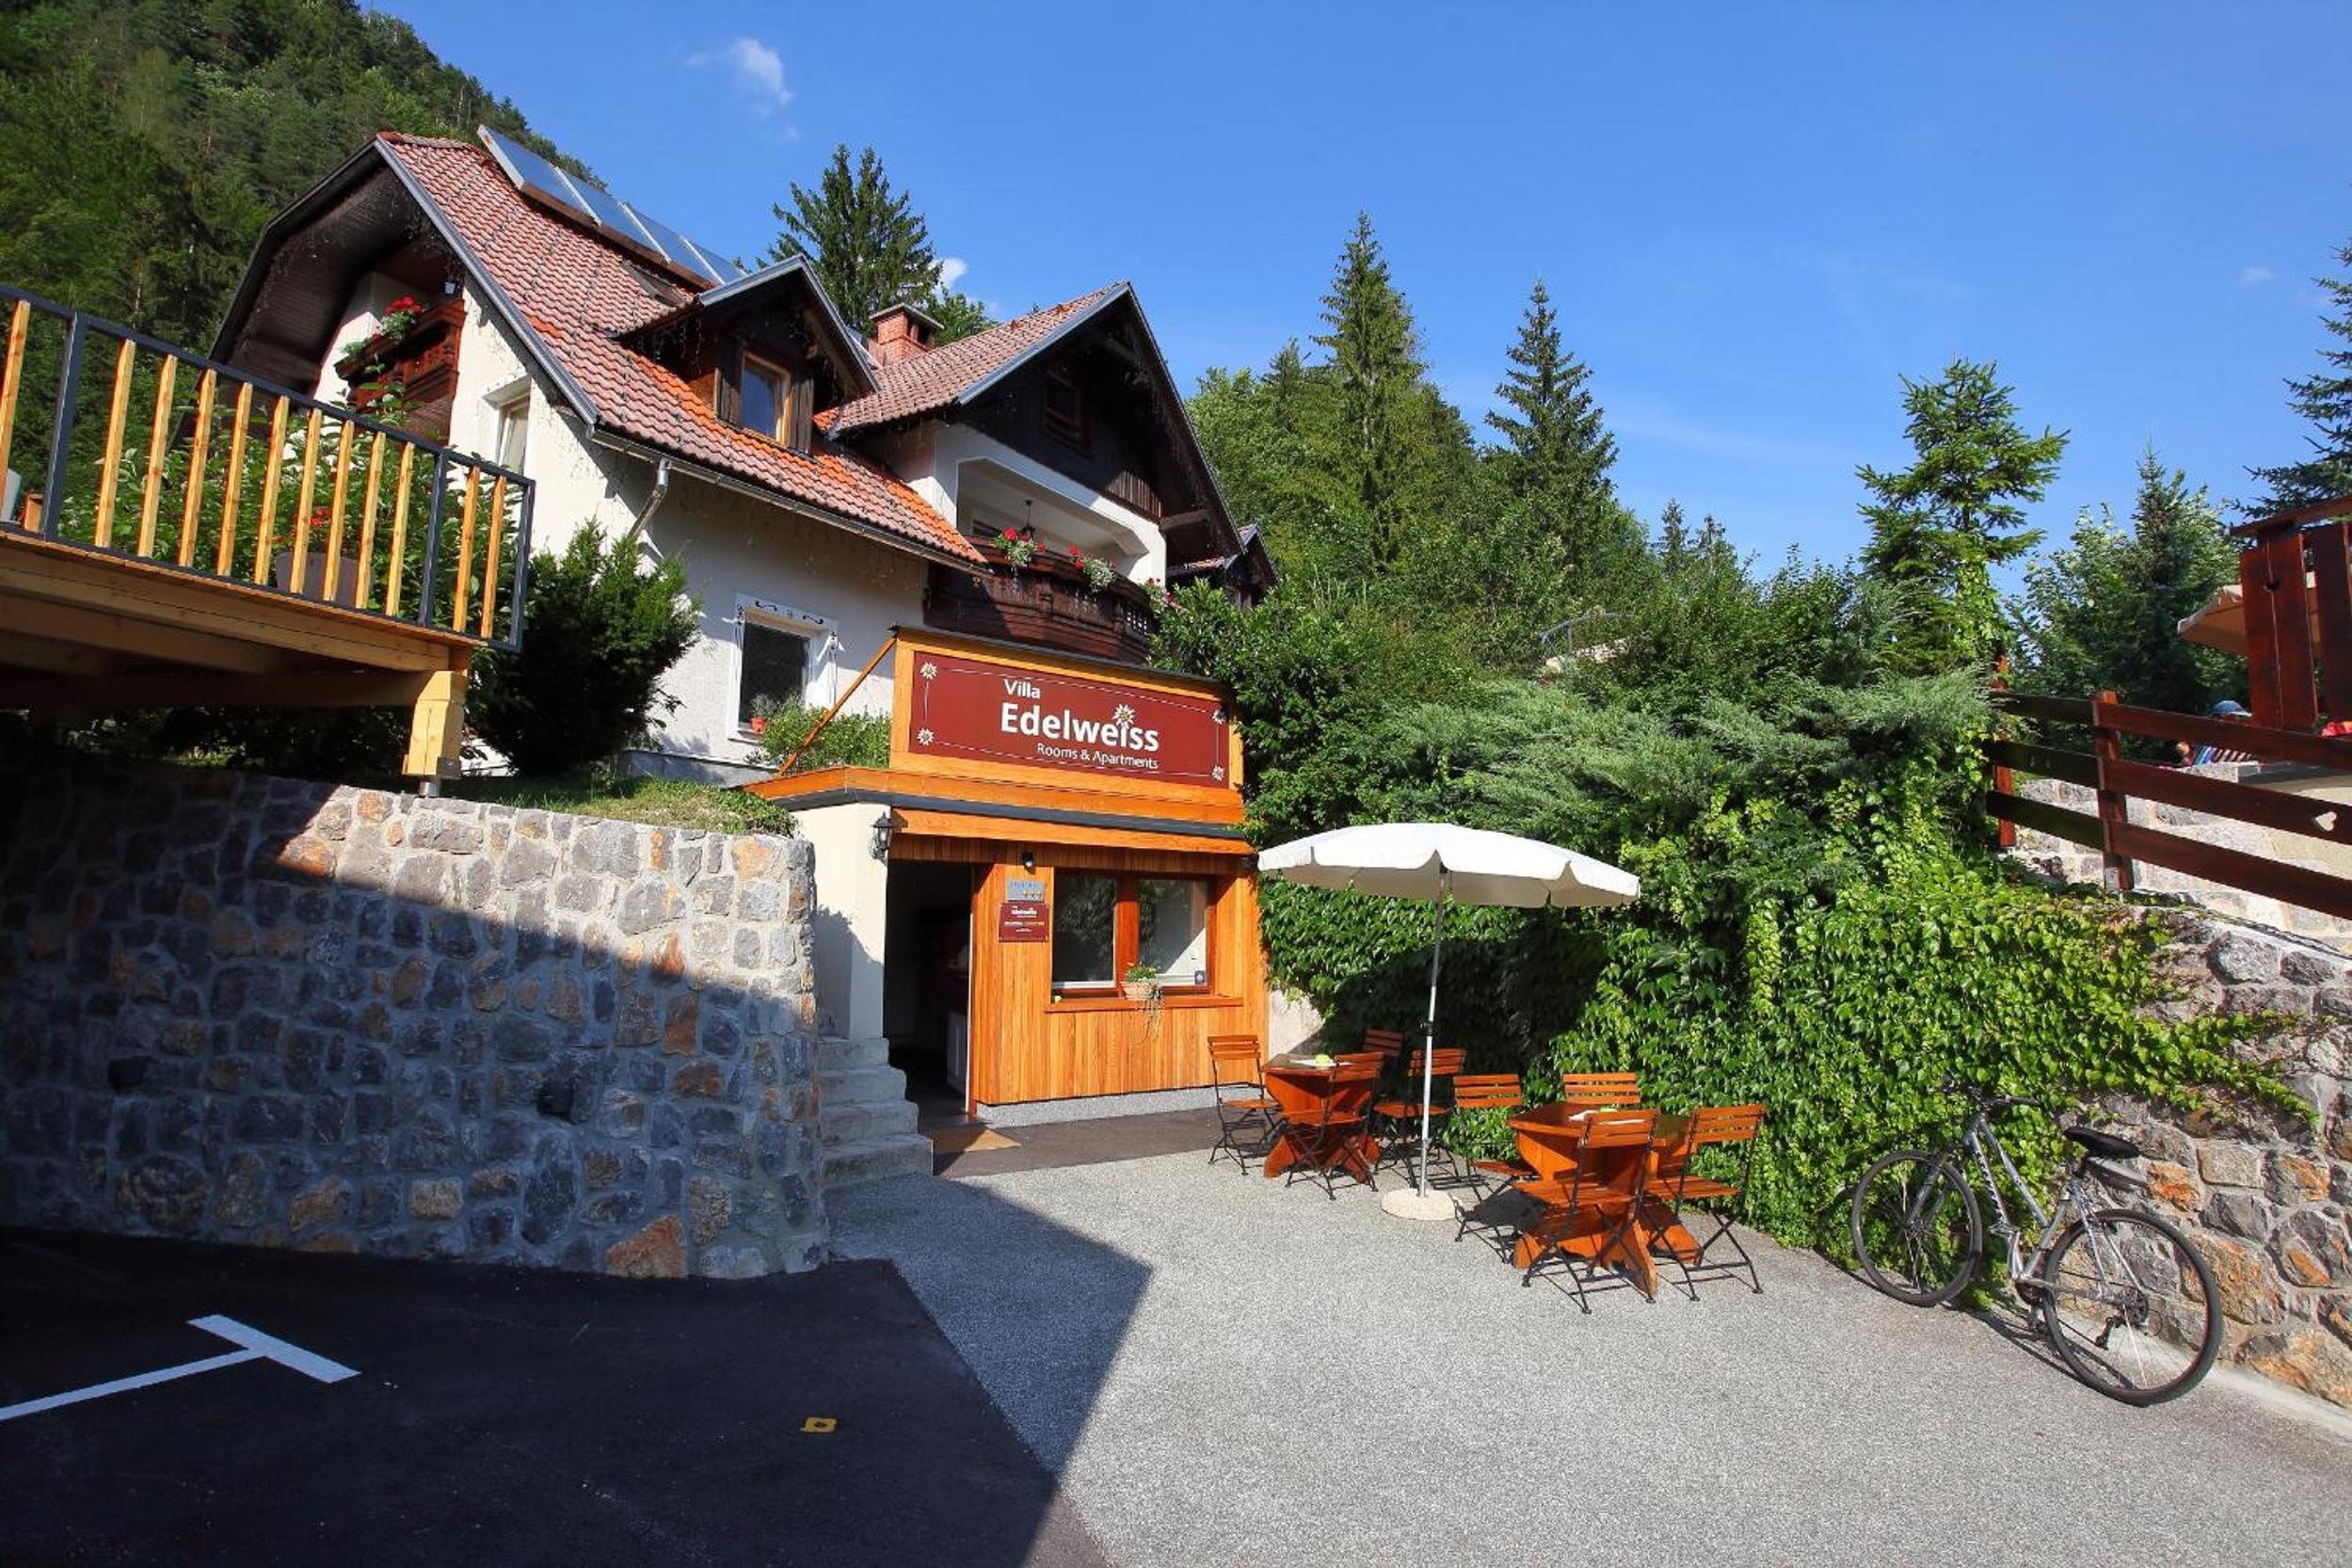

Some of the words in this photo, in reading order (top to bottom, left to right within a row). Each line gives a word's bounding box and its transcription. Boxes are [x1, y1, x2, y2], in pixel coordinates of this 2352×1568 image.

[1003, 679, 1040, 699] Villa
[1001, 702, 1160, 752] Edelweiss
[1037, 743, 1079, 760] Rooms
[1080, 749, 1091, 761] &
[1092, 750, 1159, 769] Apartments
